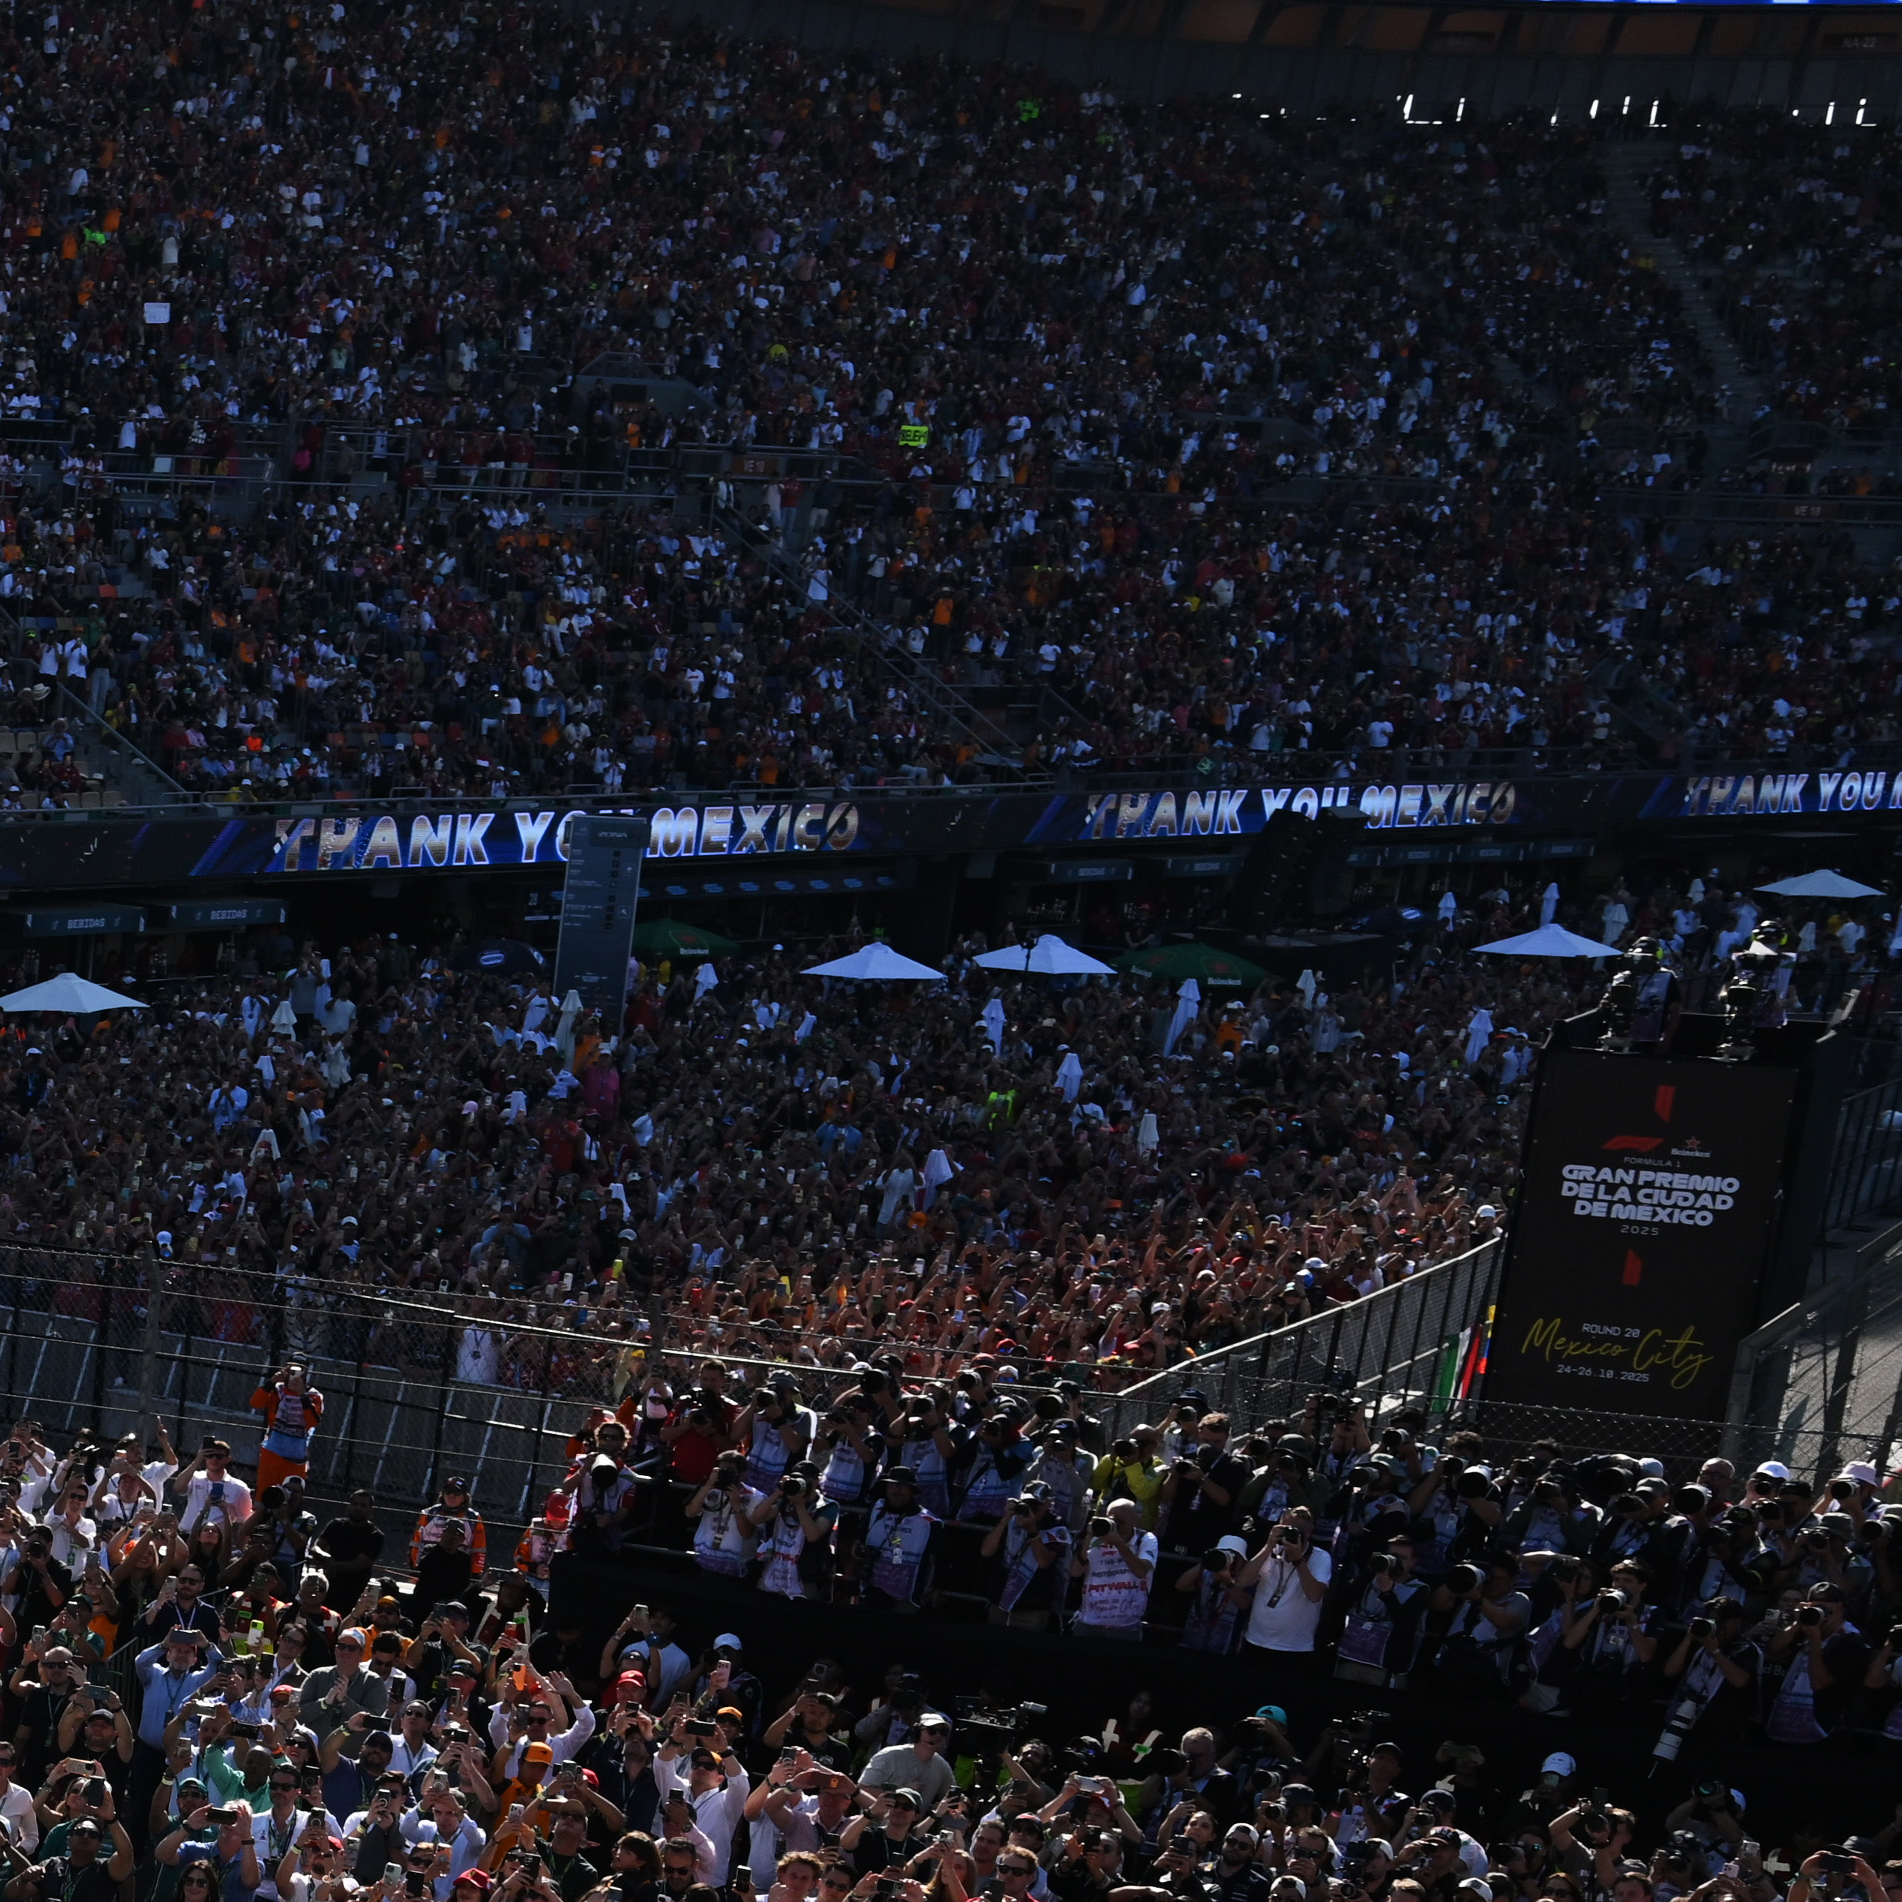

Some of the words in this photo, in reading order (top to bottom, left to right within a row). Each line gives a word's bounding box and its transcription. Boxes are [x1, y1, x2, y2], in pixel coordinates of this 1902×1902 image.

[1684, 773, 1809, 816] THANK
[1818, 771, 1887, 812] YOU
[1085, 789, 1248, 839] THANK
[1359, 781, 1515, 829] MEXICO
[275, 813, 496, 872] THANK
[646, 801, 859, 858] MEXICO
[67, 918, 105, 929] BEBIDAS
[210, 909, 247, 920] BEBIDAS
[1623, 1156, 1673, 1168] FORMULA
[1562, 1164, 1635, 1185] GRAN
[1638, 1170, 1740, 1194] PREMIO
[1561, 1181, 1595, 1199] DE
[1597, 1184, 1632, 1202] LA
[1637, 1188, 1734, 1211] CIUDAD
[1574, 1200, 1607, 1218] DE
[1620, 1224, 1659, 1236] 2025
[1582, 1323, 1622, 1337] ROUND
[1624, 1327, 1641, 1338] 20
[1521, 1318, 1630, 1363] Mexico
[1632, 1325, 1714, 1389] City
[1557, 1364, 1650, 1383] 24-26.10.2025
